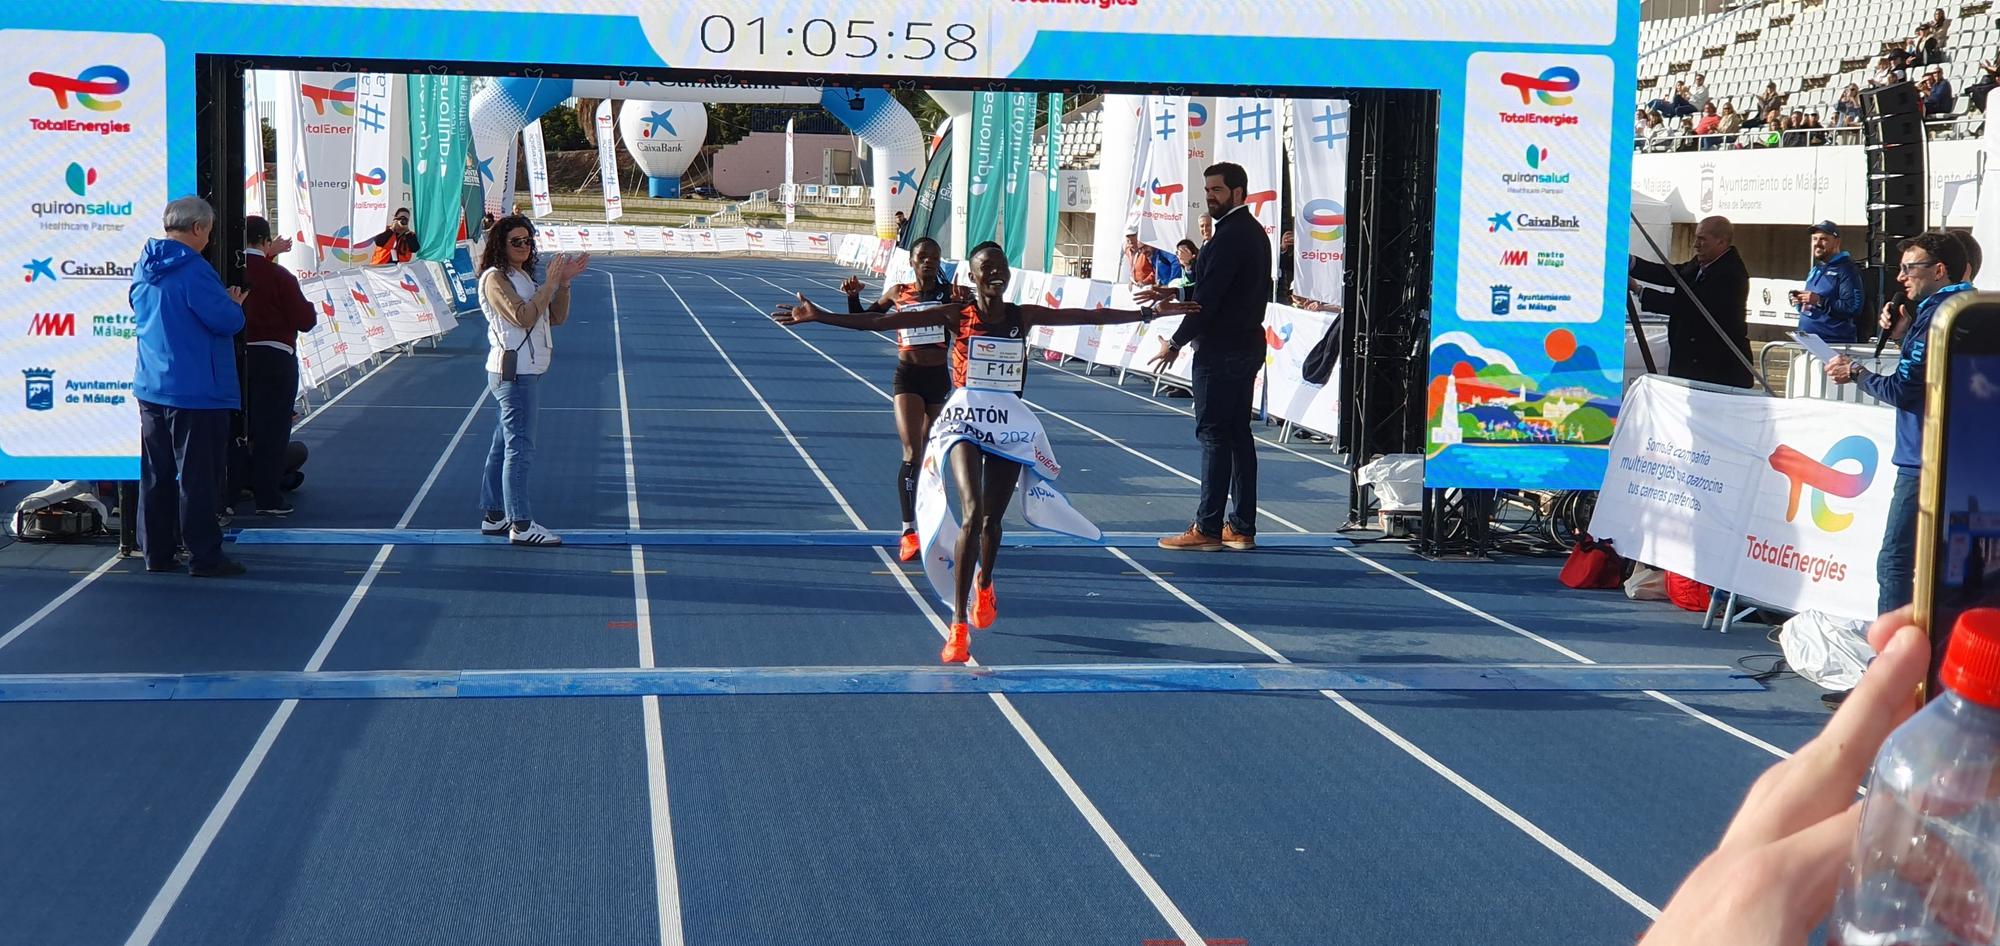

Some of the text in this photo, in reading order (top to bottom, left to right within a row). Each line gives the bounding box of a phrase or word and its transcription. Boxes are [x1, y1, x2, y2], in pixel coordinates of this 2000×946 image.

[700, 14, 977, 61] 01:05:58
[29, 118, 131, 135] TotalEnergies
[1498, 112, 1578, 127] TotalEnergies
[637, 141, 683, 153] CaixaBank
[1719, 173, 1829, 196] Ayuntamiento de Málaga
[40, 221, 89, 231] Healthcare
[1517, 213, 1580, 228] CaixaBank
[1517, 293, 1571, 302] Ayuntamiento
[93, 325, 138, 339] Málaga
[987, 362, 1014, 376] F14
[65, 392, 125, 405] de Málaga
[937, 405, 1009, 425] ARATÓN
[1628, 481, 1639, 496] tus
[1640, 485, 1667, 503] carreras
[1746, 534, 1847, 582] TotalEnergies
